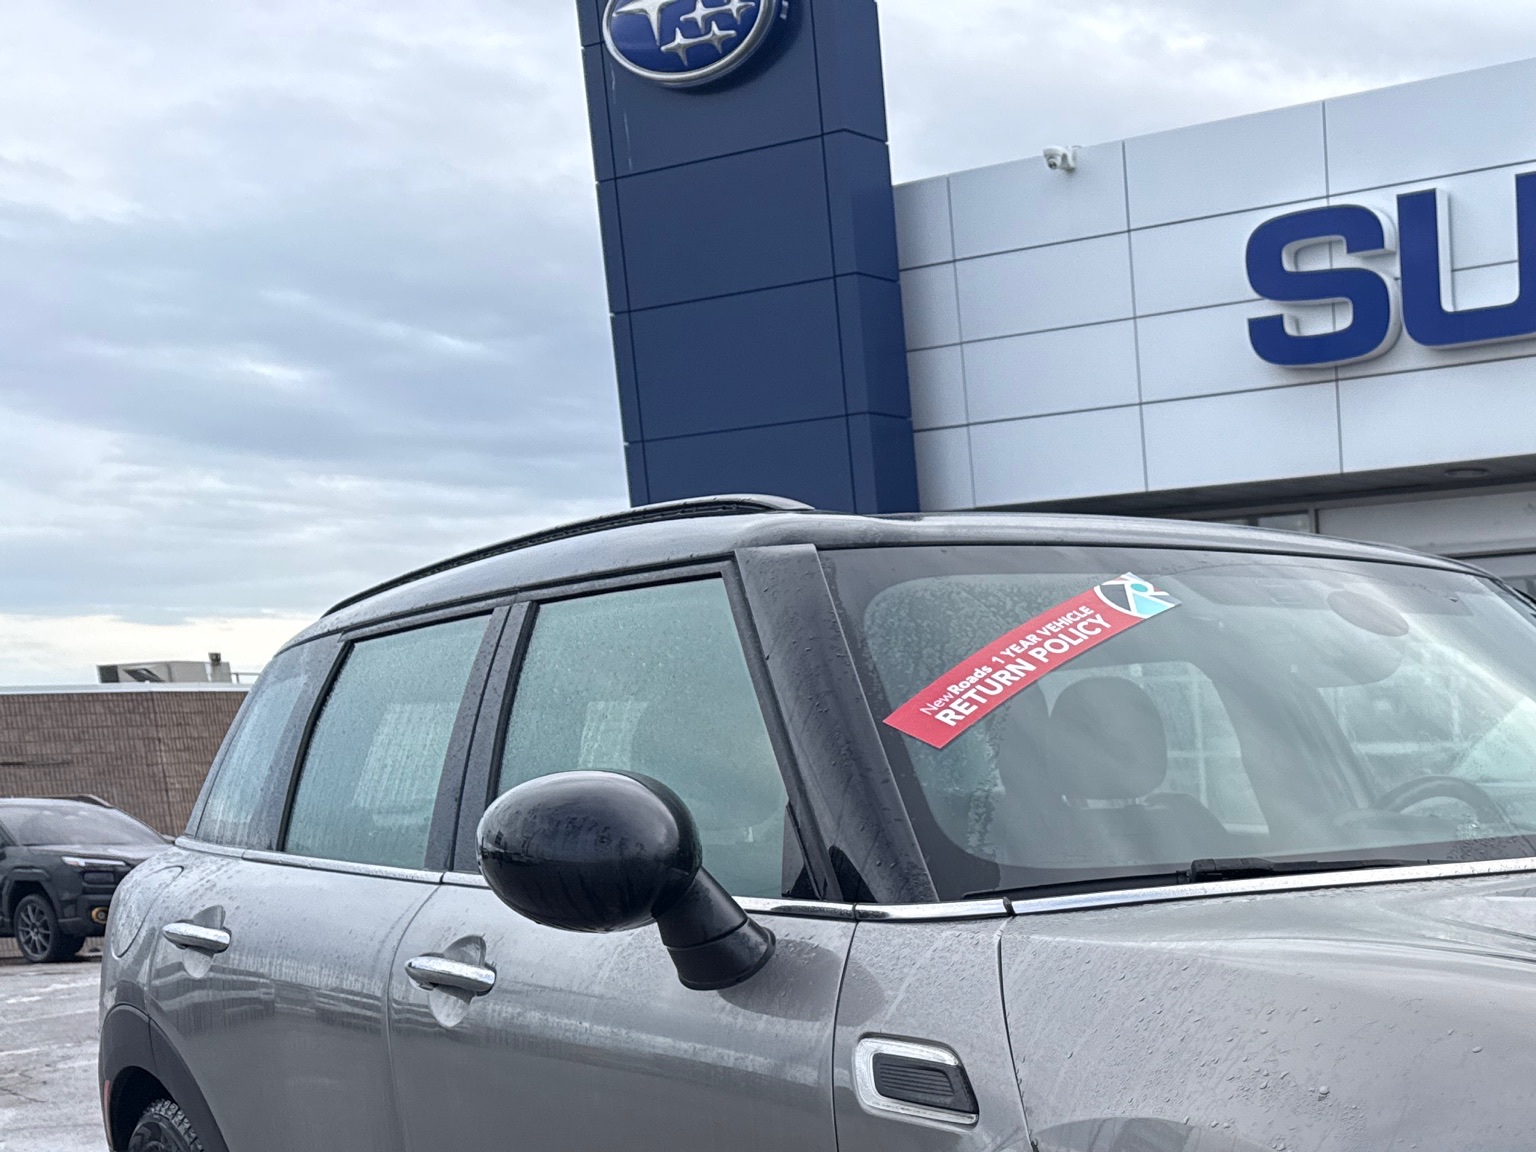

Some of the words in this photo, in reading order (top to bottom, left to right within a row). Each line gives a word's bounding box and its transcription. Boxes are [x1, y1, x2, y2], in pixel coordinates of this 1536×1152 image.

[919, 664, 993, 716] NewRoads
[1000, 633, 1039, 658] YEAR
[1039, 605, 1094, 637] VEHICLE
[934, 657, 1037, 727] RETURN
[1027, 613, 1112, 663] POLICY
